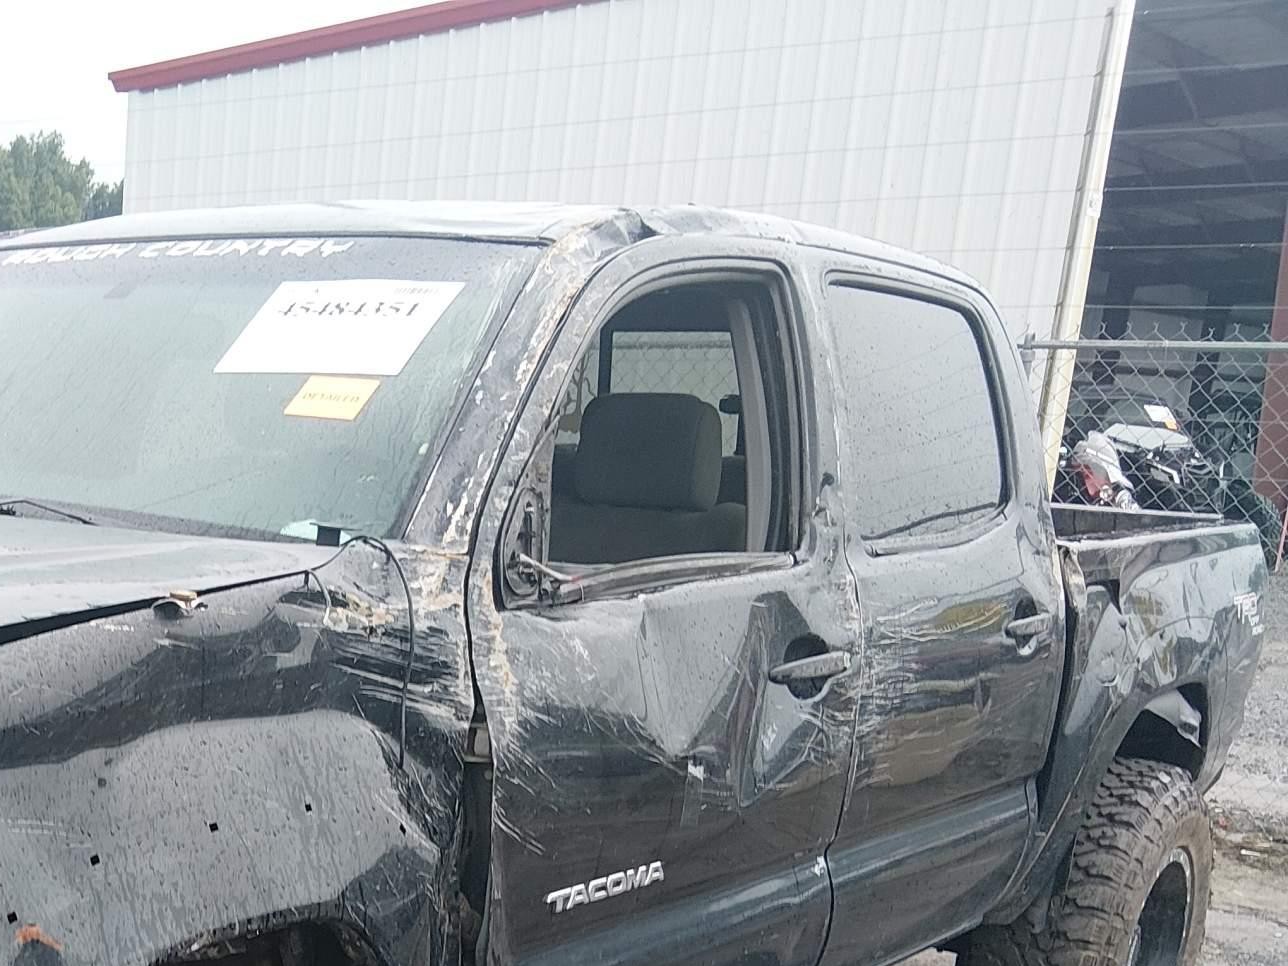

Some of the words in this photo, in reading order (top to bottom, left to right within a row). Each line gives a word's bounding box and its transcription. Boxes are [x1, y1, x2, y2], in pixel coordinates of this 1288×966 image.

[2, 243, 136, 266] ROUGH
[139, 240, 354, 259] COUNTRY
[278, 301, 420, 316] 45484351
[545, 861, 665, 913] TACOMA
